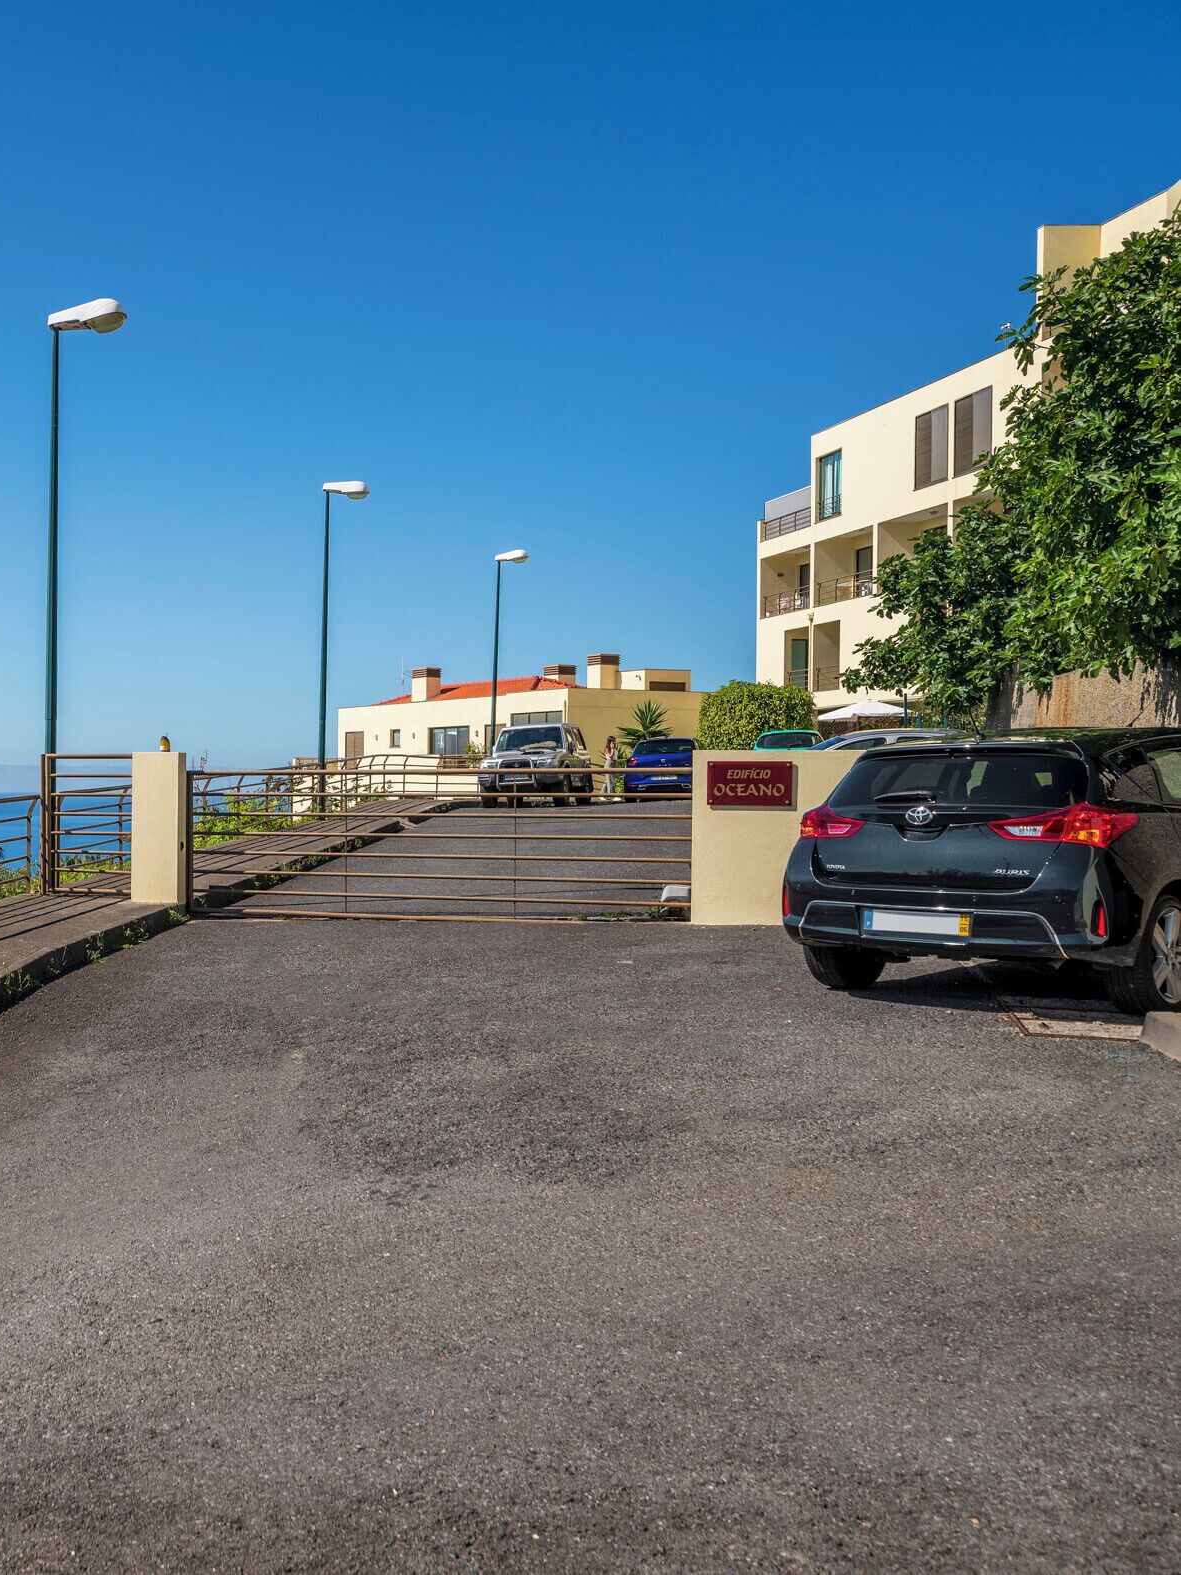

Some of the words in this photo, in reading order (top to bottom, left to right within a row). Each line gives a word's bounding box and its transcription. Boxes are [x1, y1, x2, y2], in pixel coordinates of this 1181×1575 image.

[726, 767, 771, 779] EDIFÍCIO
[713, 783, 785, 796] OCEANO
[993, 868, 1030, 876] AURIS
